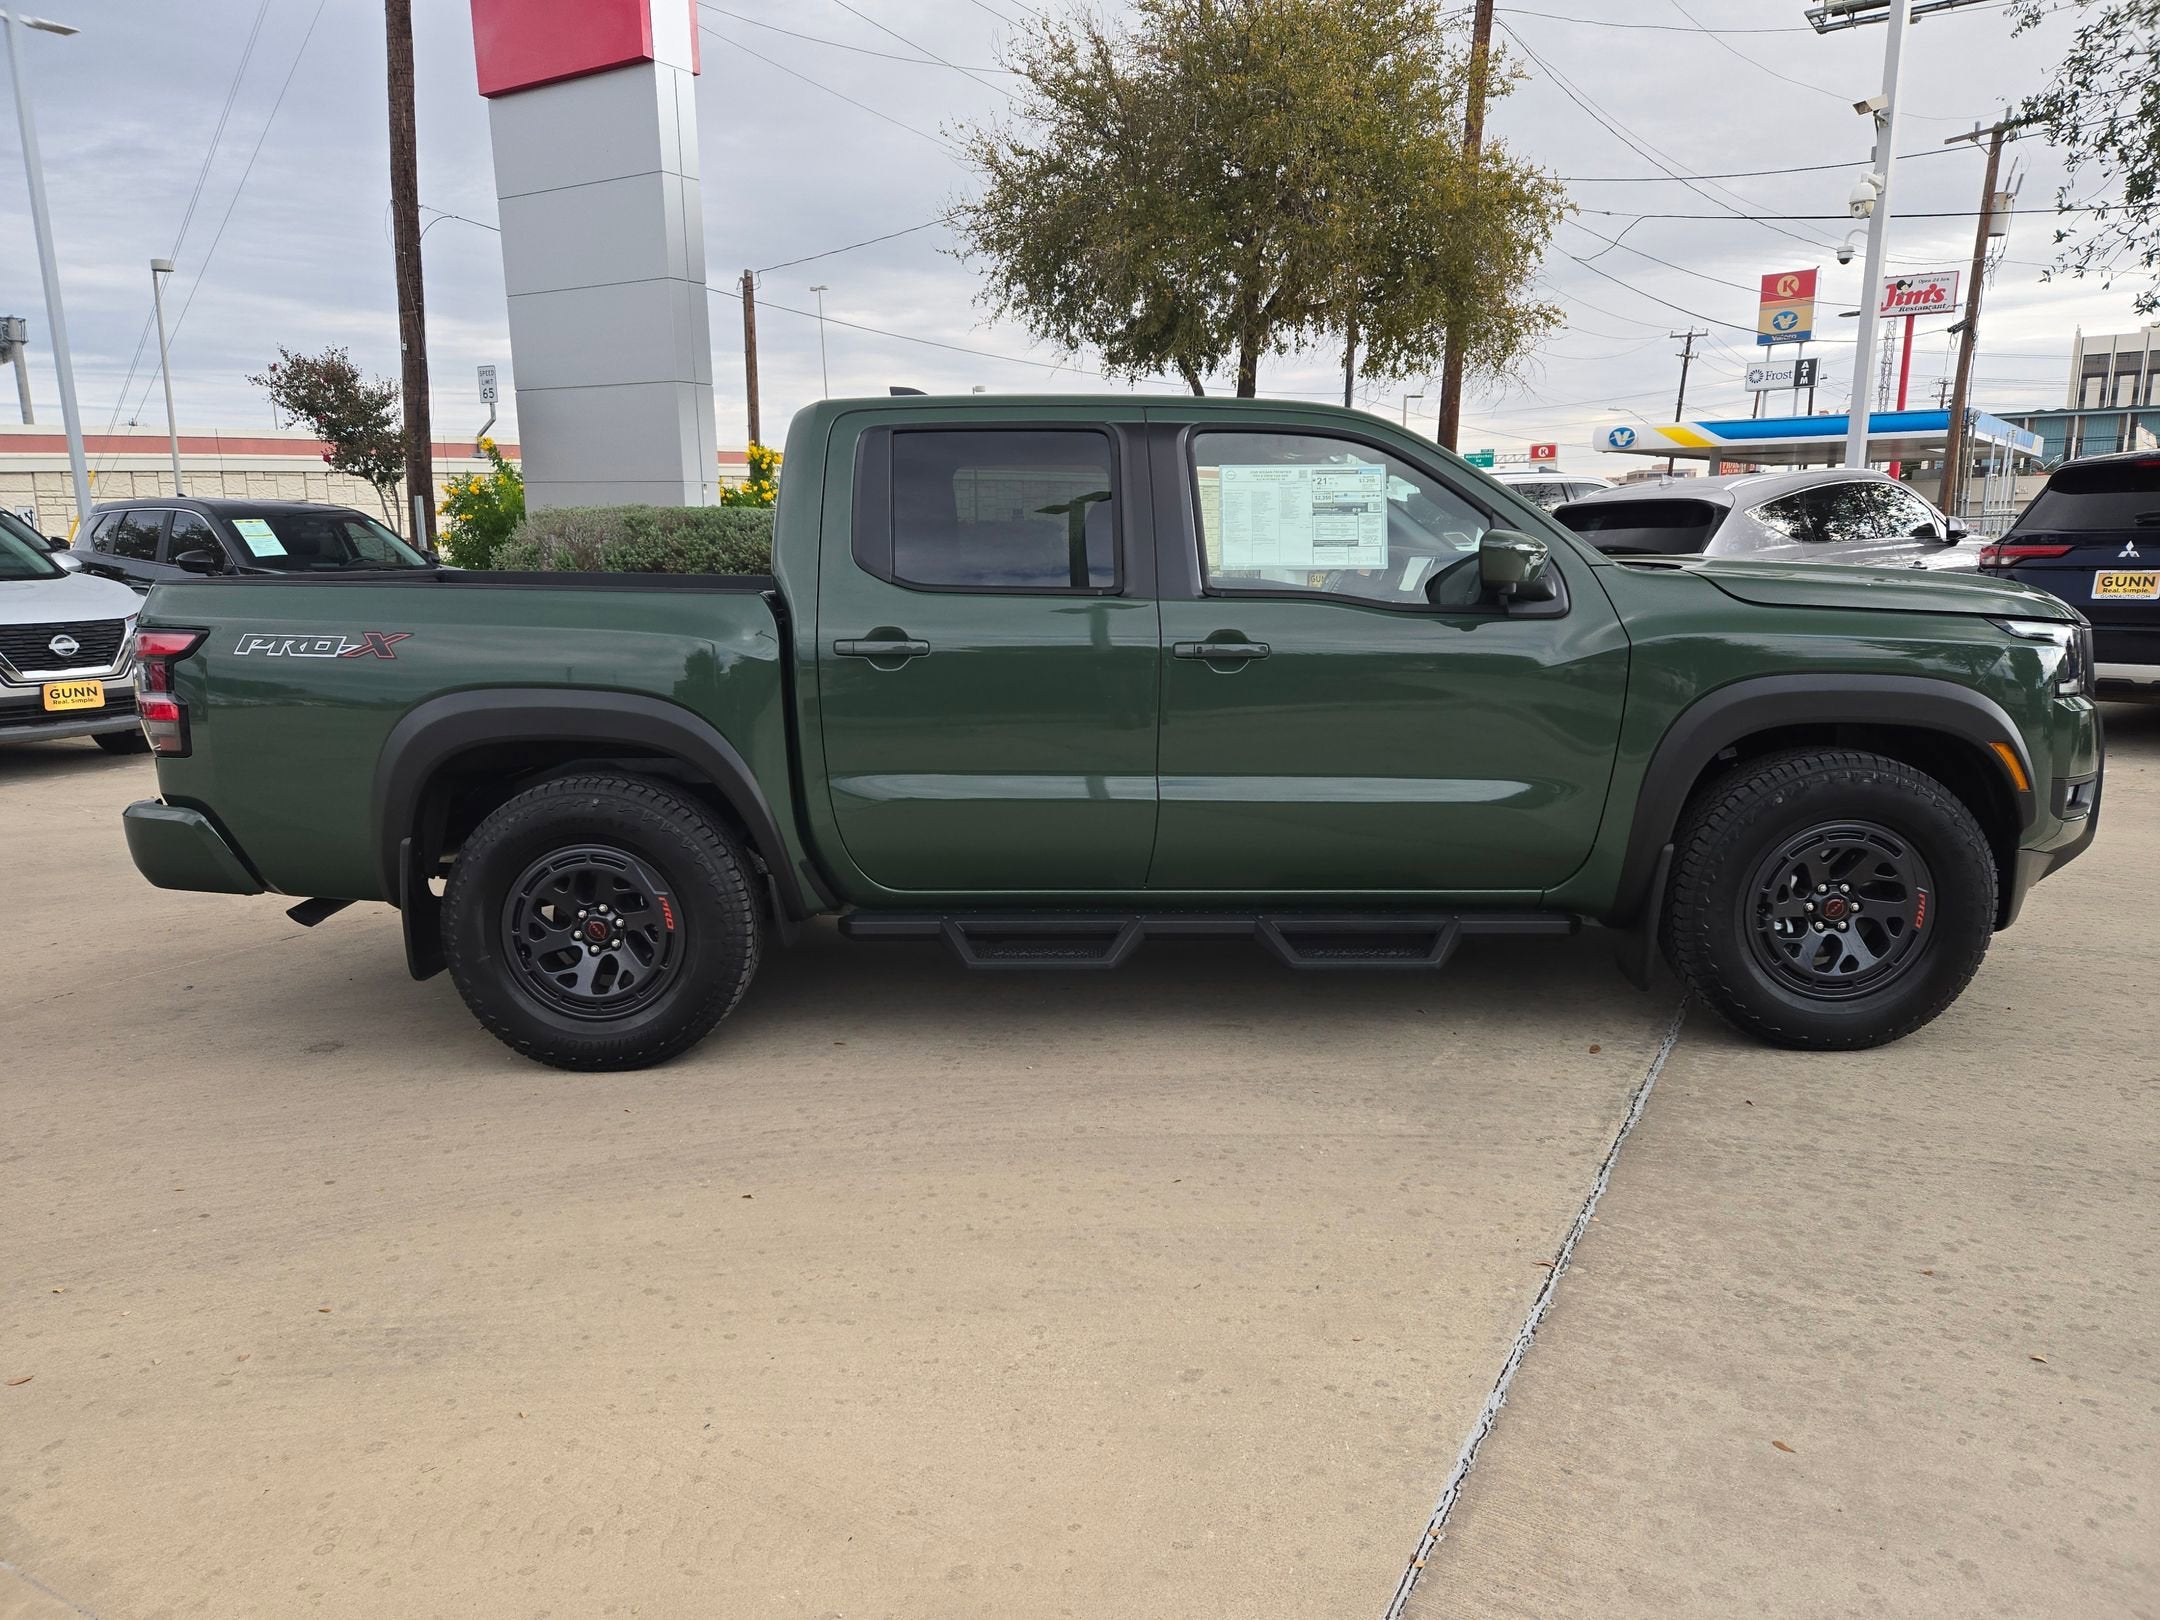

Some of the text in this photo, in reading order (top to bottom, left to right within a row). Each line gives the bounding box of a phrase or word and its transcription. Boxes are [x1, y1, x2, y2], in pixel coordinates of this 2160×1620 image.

[1880, 283, 1946, 312] Jim's
[1898, 303, 1947, 312] Restaurant
[1765, 369, 1792, 380] Frost
[1800, 361, 1810, 384] ATM
[483, 387, 495, 399] 65
[1317, 477, 1327, 485] 21
[2101, 576, 2156, 587] GUNN
[49, 686, 98, 699] GUNN
[657, 896, 675, 930] PRO
[1915, 893, 1926, 929] PRO
